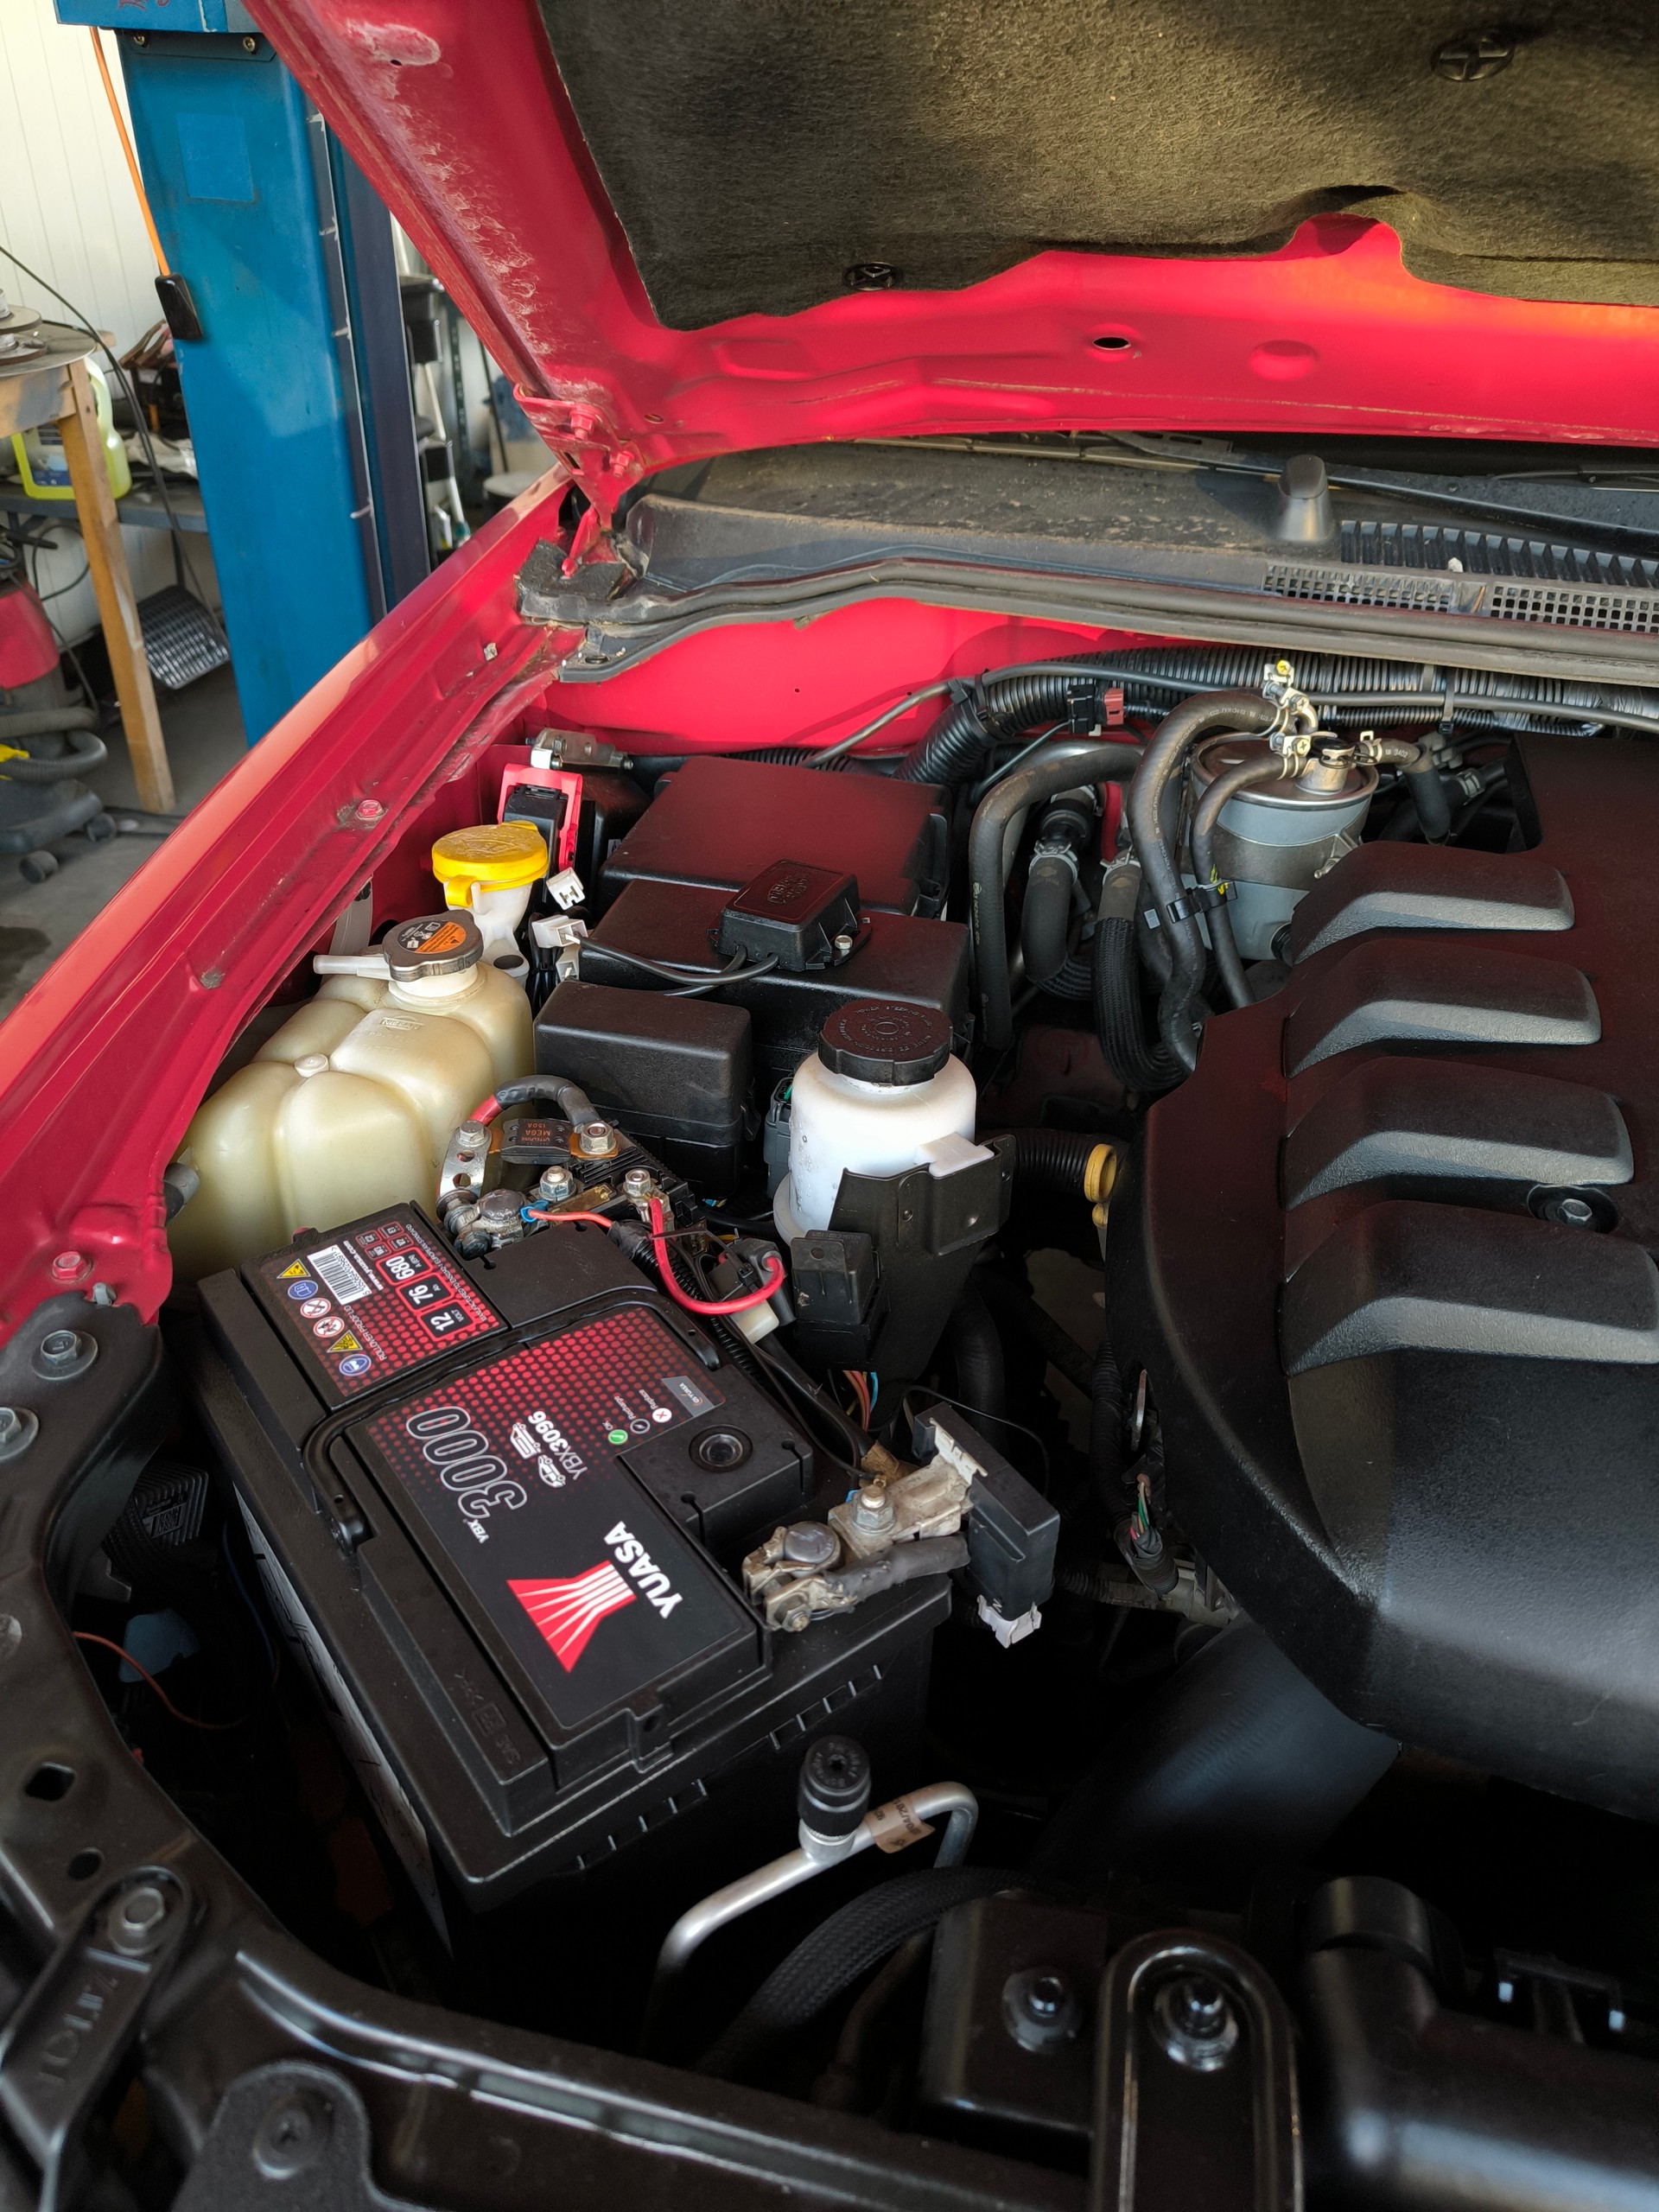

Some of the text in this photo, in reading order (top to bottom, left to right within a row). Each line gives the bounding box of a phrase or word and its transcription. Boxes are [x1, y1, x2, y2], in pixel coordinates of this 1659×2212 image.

[1394, 749, 1408, 758] 3402
[343, 1240, 384, 1291] www.yuasa.com
[385, 1255, 415, 1280] 680
[409, 1285, 434, 1305] 76
[351, 1314, 366, 1332] PROOF
[430, 1313, 456, 1331] 12
[451, 1309, 464, 1321] VOLT
[613, 1395, 636, 1420] Recharge
[639, 1389, 658, 1409] Replace
[528, 1410, 588, 1480] YBX3096
[405, 1405, 528, 1519] 3000
[602, 1521, 683, 1619] YUASA
